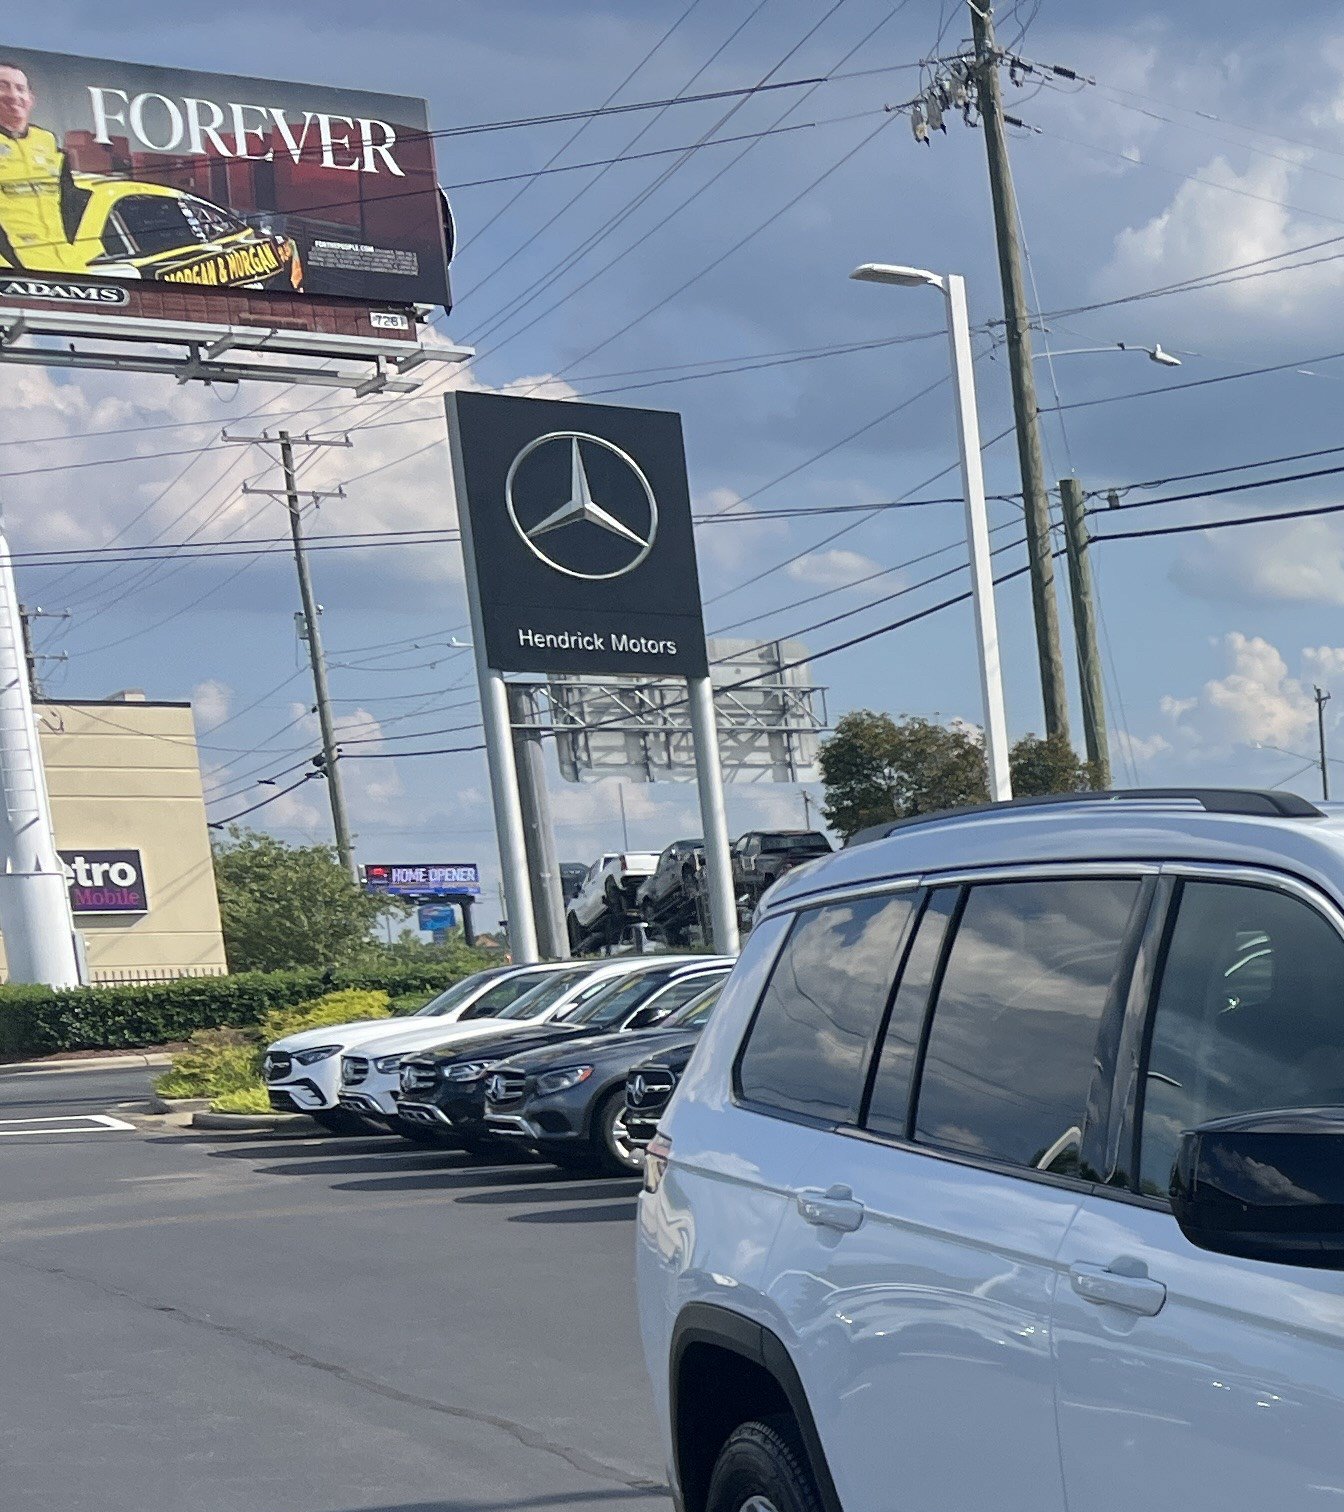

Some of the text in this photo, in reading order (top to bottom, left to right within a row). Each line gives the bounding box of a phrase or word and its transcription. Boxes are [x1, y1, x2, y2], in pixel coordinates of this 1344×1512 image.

[87, 85, 405, 178] FOREVER
[165, 259, 217, 286] RGAN
[228, 242, 279, 280] MORGAN
[2, 281, 118, 301] ADAMS
[518, 628, 677, 655] Hendrick Motors
[64, 855, 137, 887] tro
[392, 868, 476, 882] HOME OPENER
[74, 888, 140, 905] Mobile
